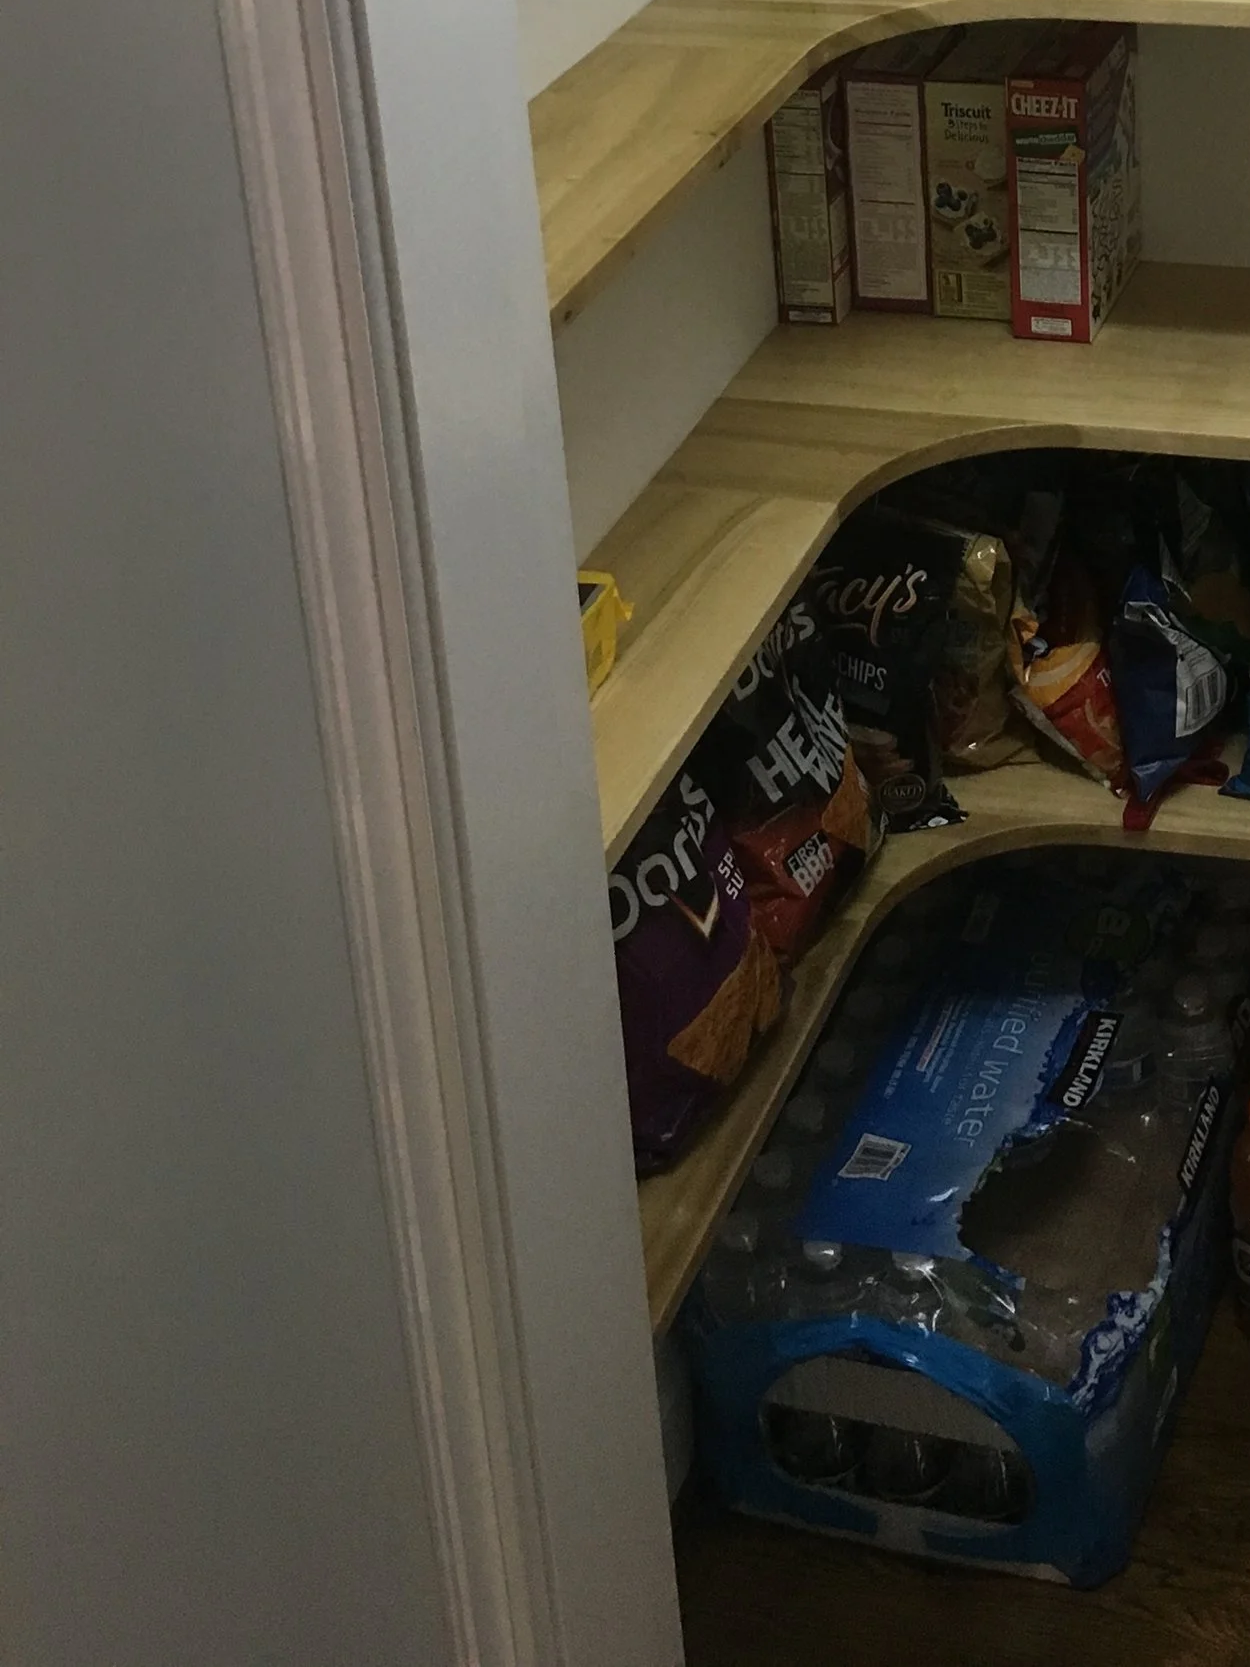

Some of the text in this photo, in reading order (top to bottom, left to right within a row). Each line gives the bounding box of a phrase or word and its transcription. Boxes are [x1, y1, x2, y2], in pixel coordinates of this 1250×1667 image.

[941, 101, 992, 120] Triscuit
[838, 651, 888, 691] CHIPS
[787, 832, 824, 874] FIRST
[792, 842, 836, 898] BBQ
[1062, 1017, 1118, 1108] KIRKLAND
[953, 1059, 1009, 1148] water
[1180, 1085, 1220, 1189] KIRKLAND
